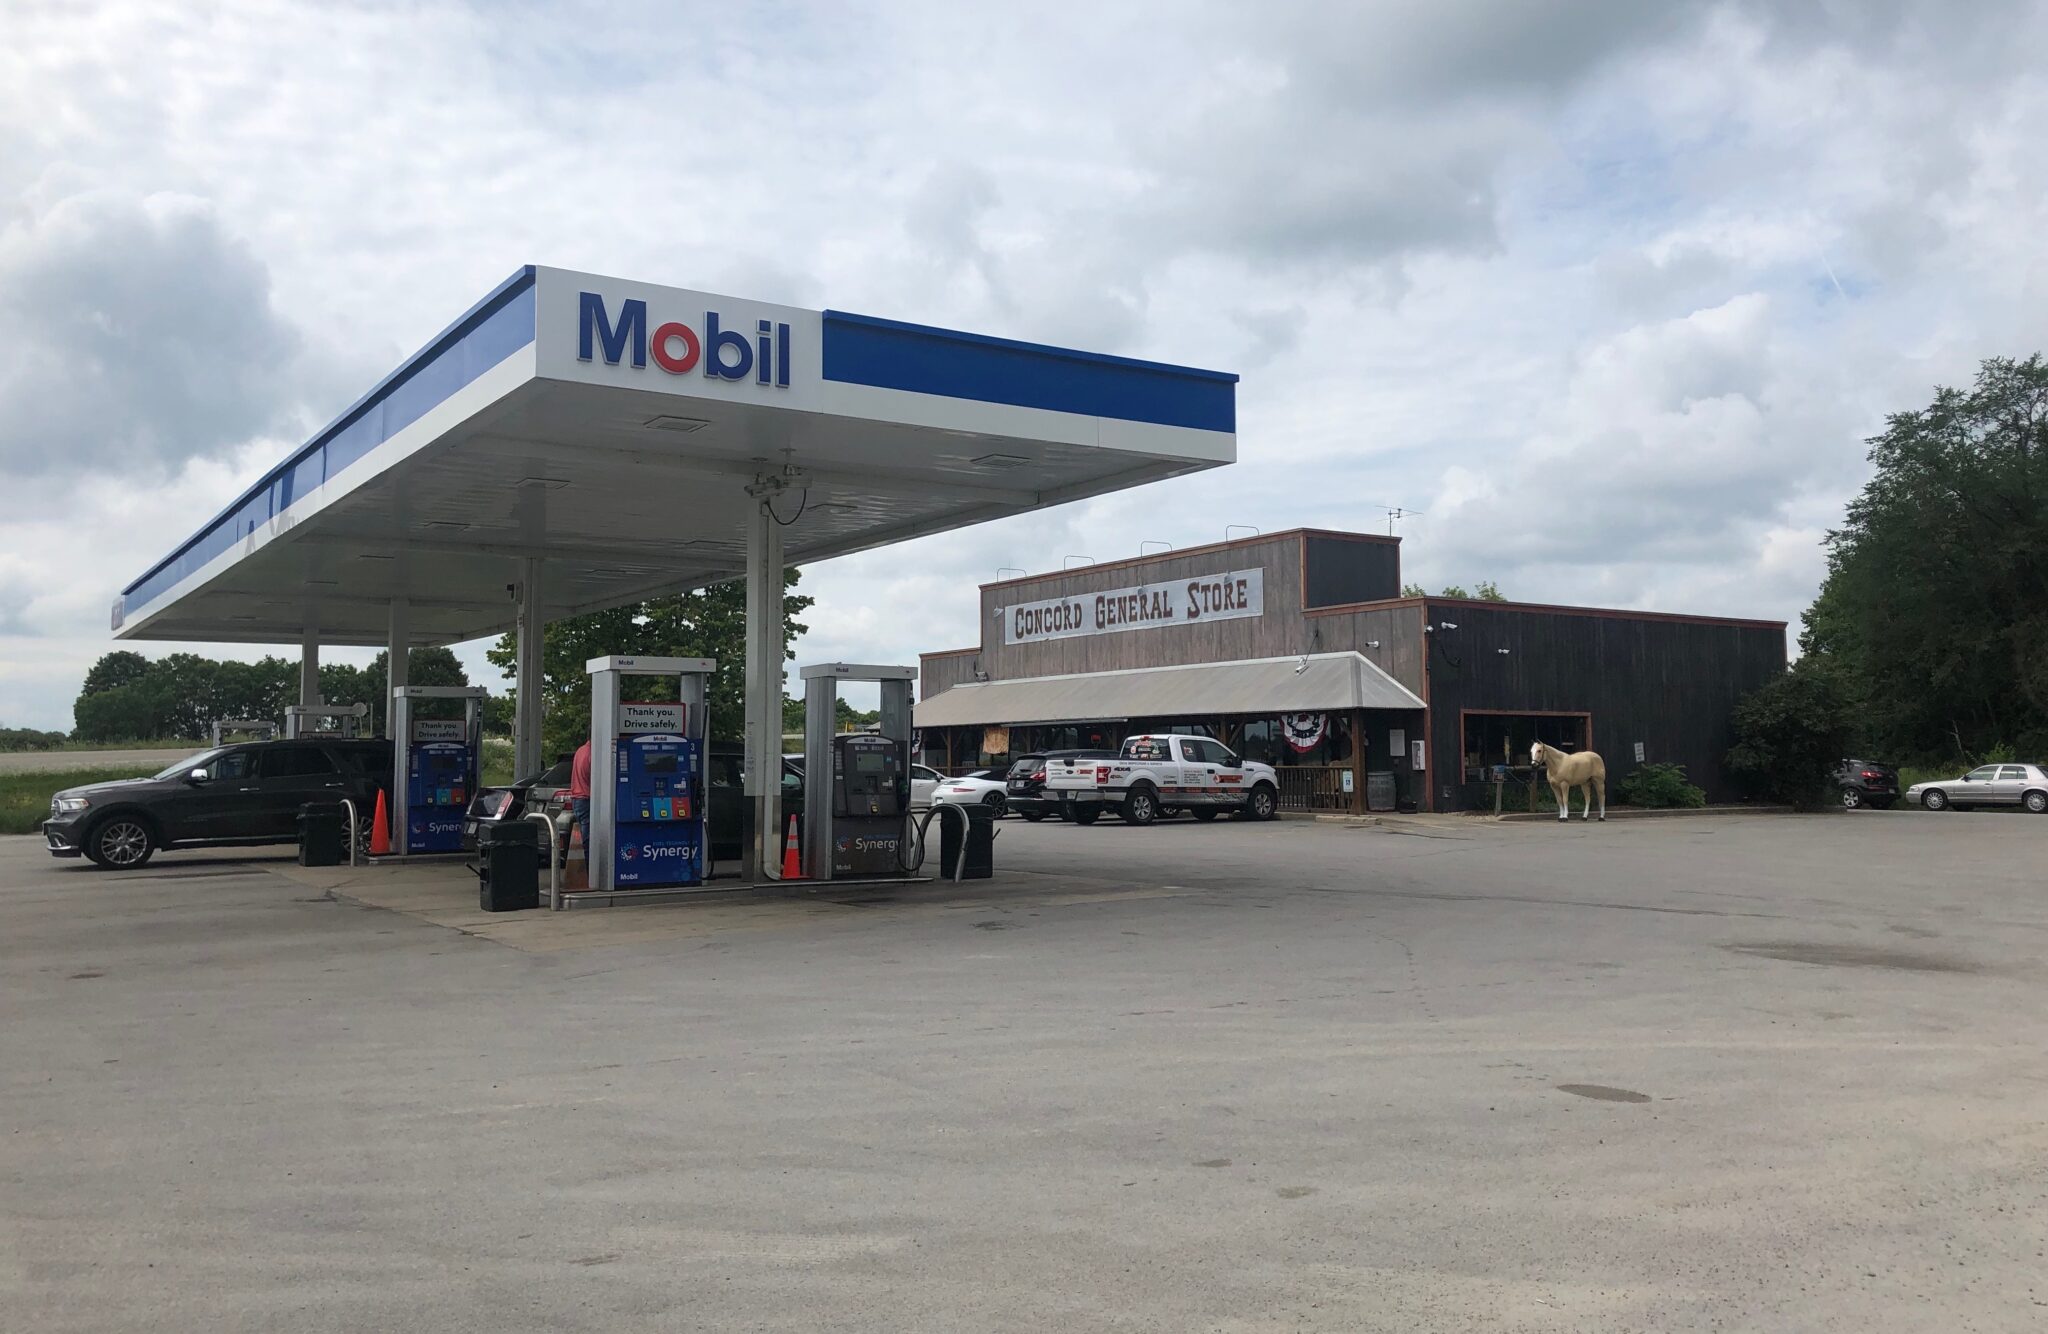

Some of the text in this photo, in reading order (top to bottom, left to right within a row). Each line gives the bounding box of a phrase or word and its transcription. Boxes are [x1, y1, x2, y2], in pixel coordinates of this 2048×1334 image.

[577, 291, 790, 388] Mobil
[1015, 579, 1248, 639] CONCORD GENERAL STORE
[627, 707, 675, 718] Thank you.
[624, 719, 678, 730] Drive safely.
[690, 743, 695, 751] 3
[429, 822, 461, 835] Syner
[643, 844, 698, 862] Synergy
[620, 873, 639, 881] Mobil
